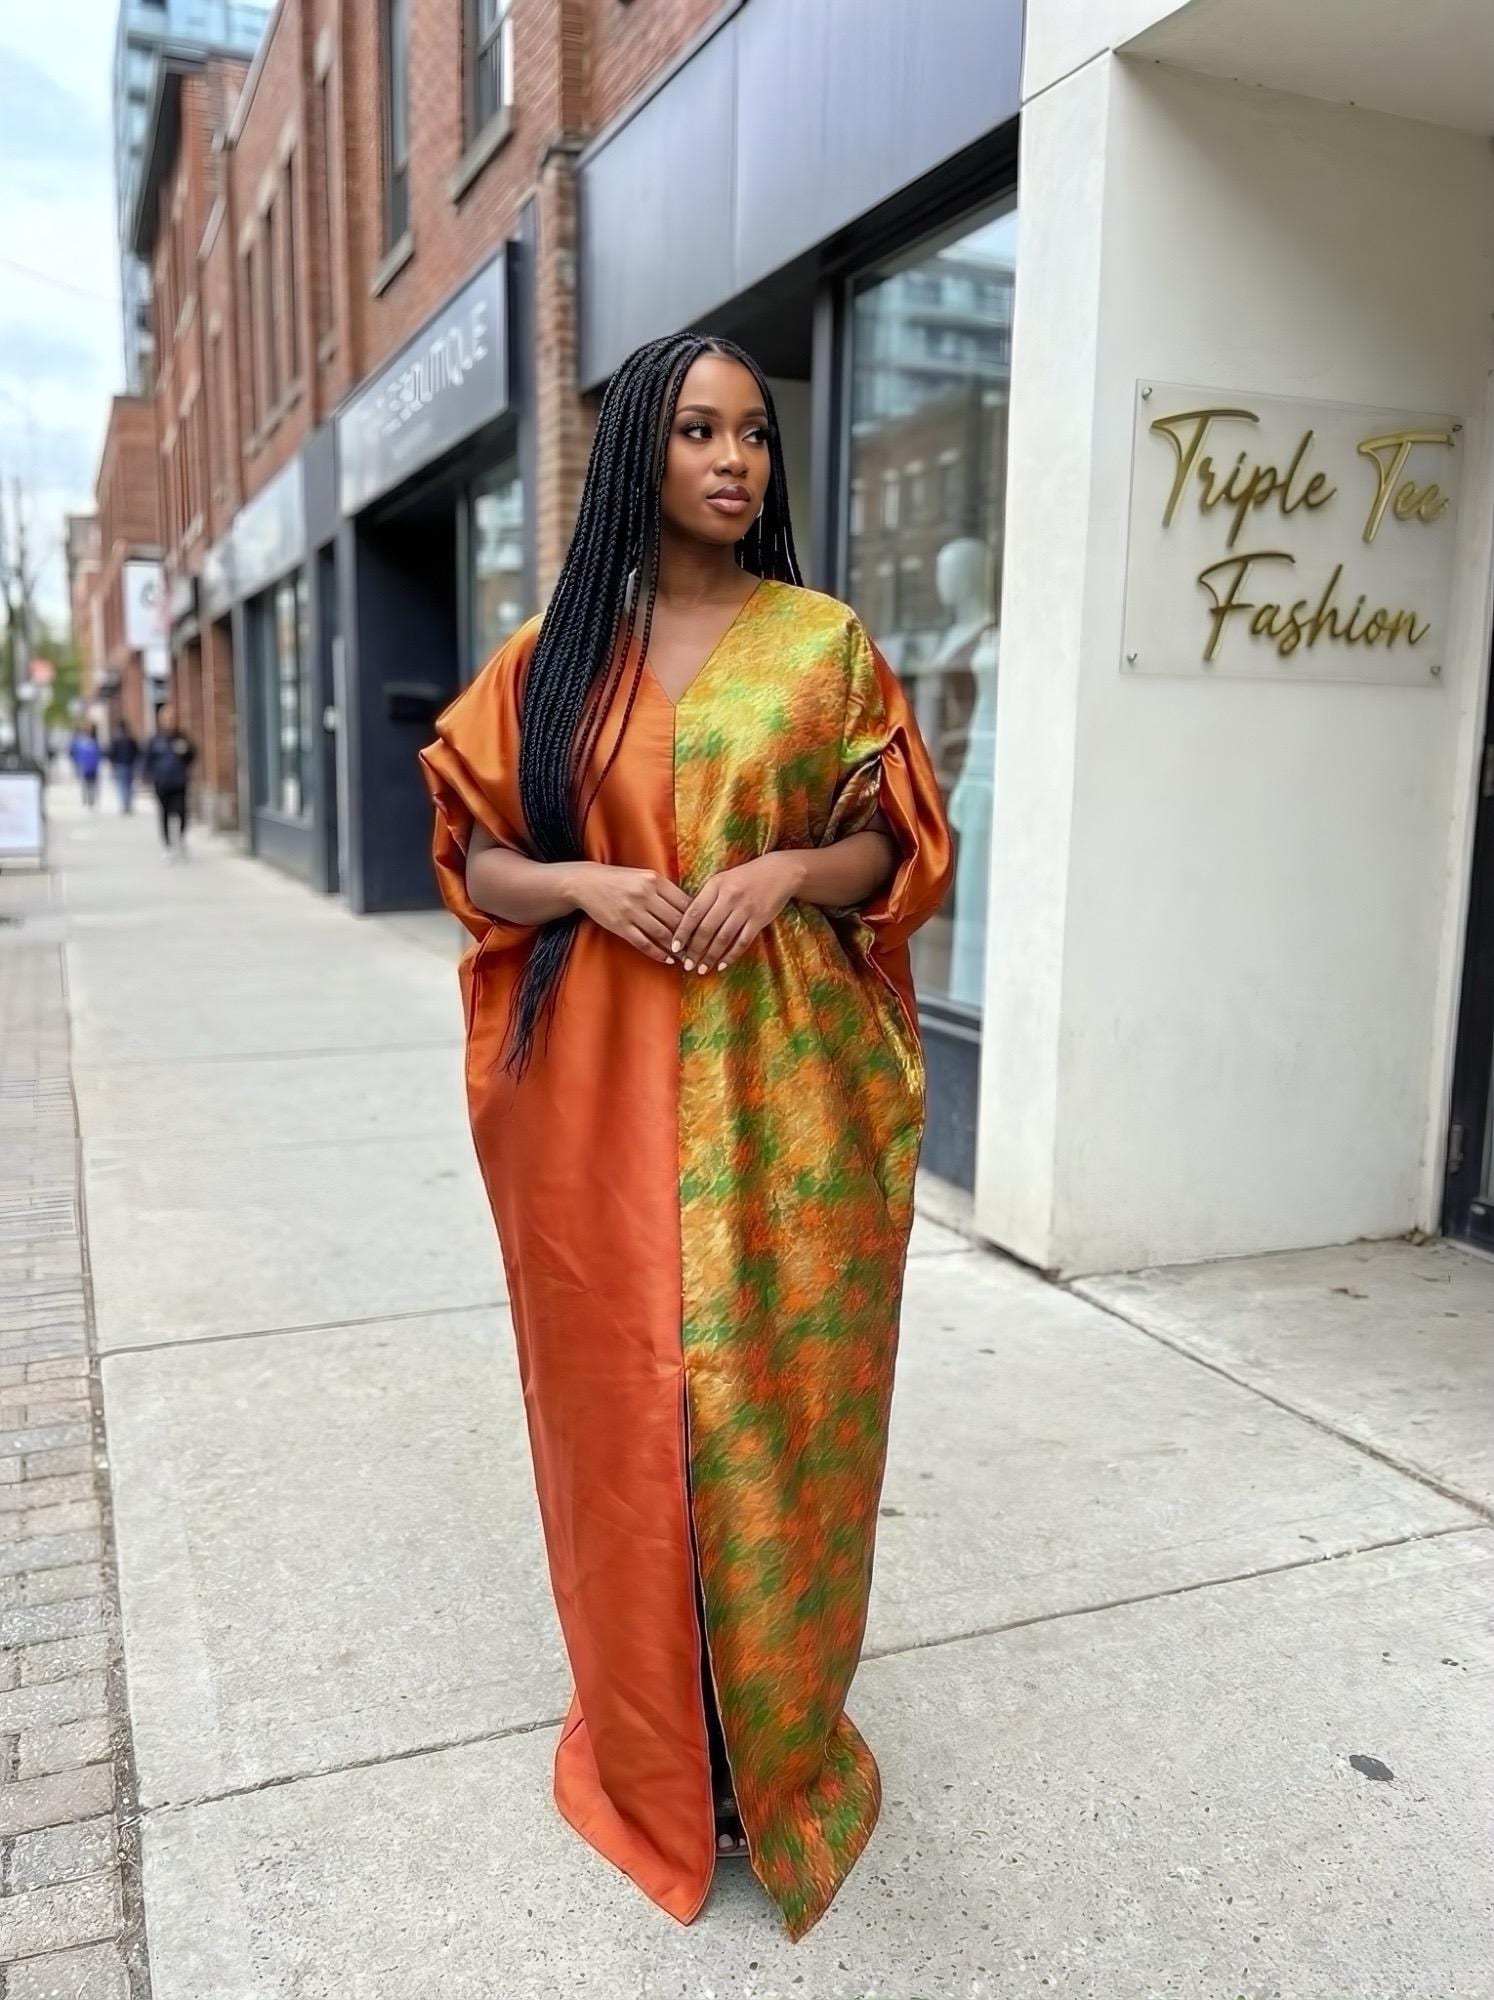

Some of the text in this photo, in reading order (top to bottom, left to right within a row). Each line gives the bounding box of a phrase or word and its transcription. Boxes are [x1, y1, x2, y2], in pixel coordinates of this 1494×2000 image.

[1150, 408, 1455, 549] Triple Tee
[1197, 551, 1431, 663] Fashion
